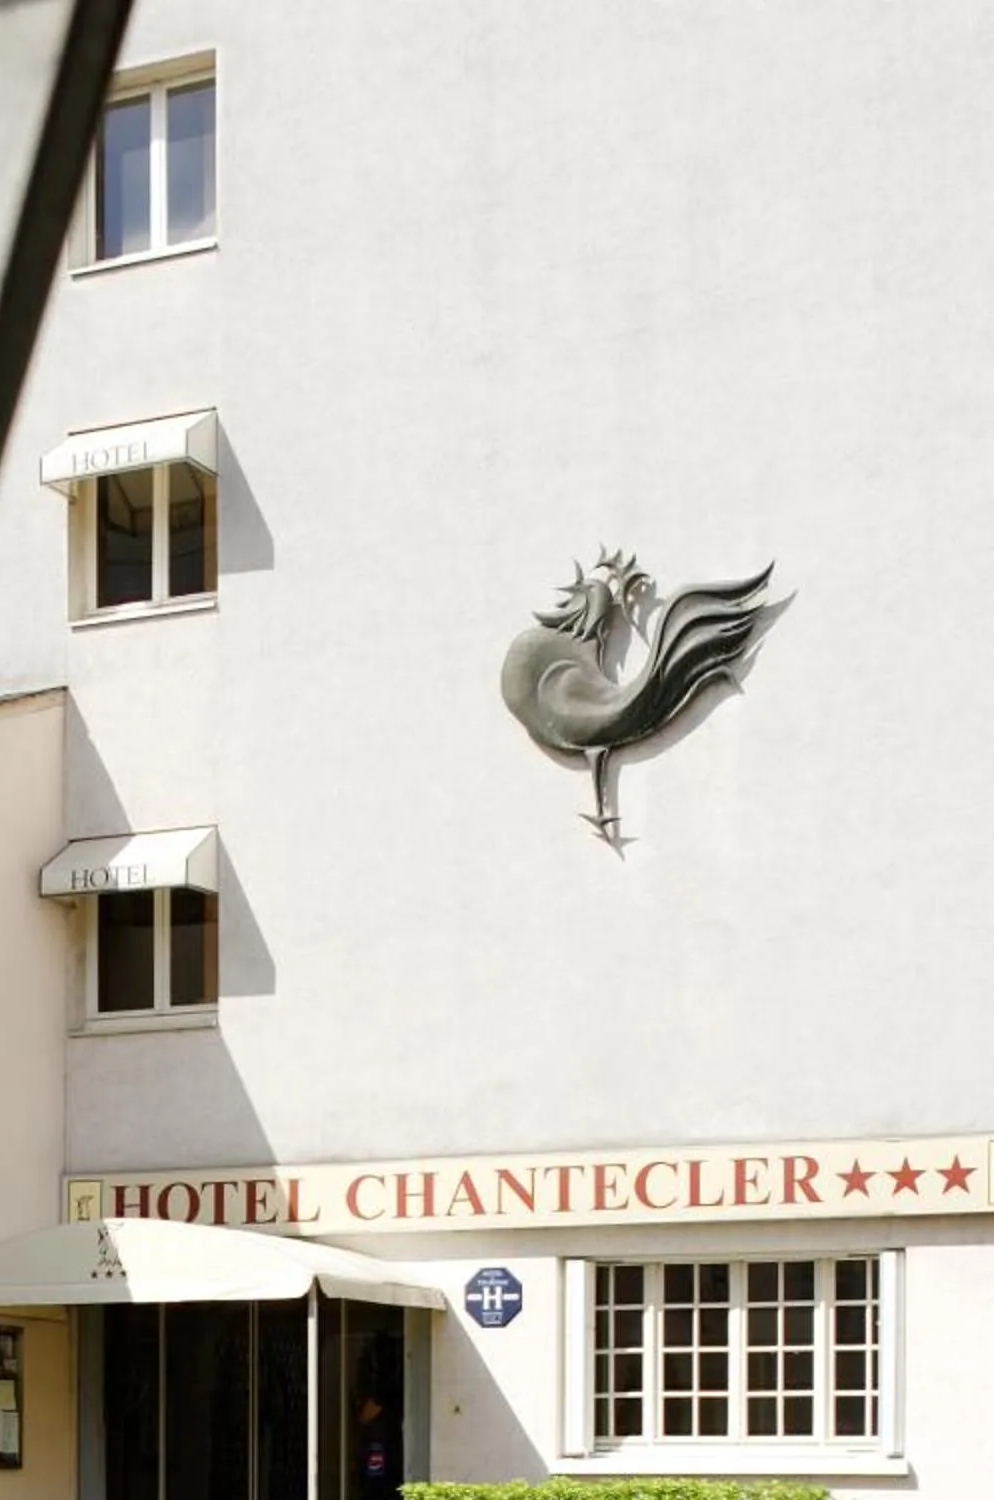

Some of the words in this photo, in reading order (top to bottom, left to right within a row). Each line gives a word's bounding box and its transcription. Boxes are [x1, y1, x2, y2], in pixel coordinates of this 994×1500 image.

[71, 440, 155, 474] HOTEL
[70, 863, 156, 891] HOTEL
[109, 1177, 320, 1226] HOTEL
[345, 1154, 825, 1221] CHANTECLER
[482, 1285, 503, 1311] H
